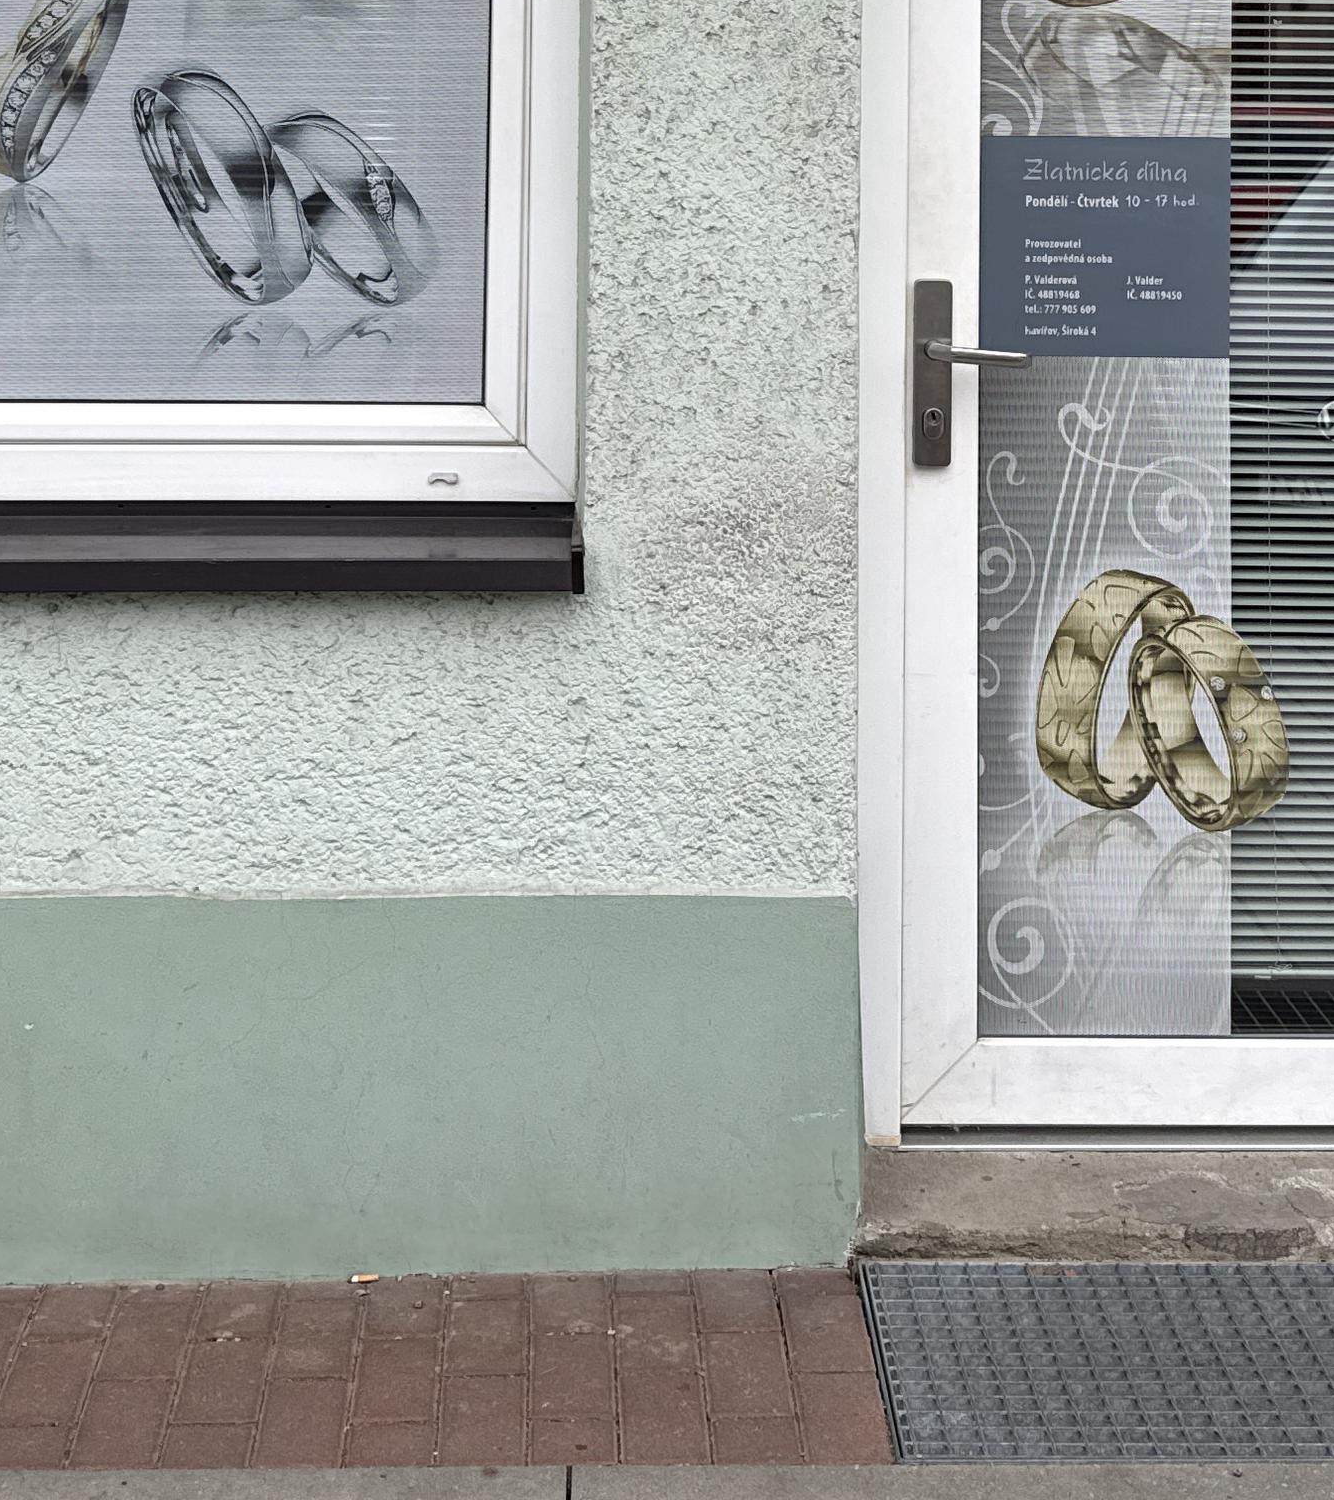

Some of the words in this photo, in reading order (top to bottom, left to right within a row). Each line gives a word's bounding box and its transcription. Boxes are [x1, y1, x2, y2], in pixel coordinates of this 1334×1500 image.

[1023, 158, 1129, 183] Zlatnická
[1136, 160, 1188, 184] dílna
[1025, 194, 1069, 208] Pondělí
[1076, 192, 1120, 208] Čtvrtek
[1125, 194, 1141, 208] 10
[1155, 194, 1168, 208] 17
[1024, 238, 1082, 249] Provozovatel
[1024, 255, 1031, 263] a
[1086, 253, 1113, 264] osoba
[1024, 274, 1033, 285] P.
[1033, 274, 1078, 285] Valderová
[1126, 275, 1134, 286] J.
[1135, 275, 1164, 286] Valder
[1024, 303, 1043, 314] tel.:
[1043, 304, 1060, 314] 777
[1061, 304, 1078, 314] 905
[1079, 304, 1097, 315] 609
[1061, 323, 1089, 336] Široká
[1090, 325, 1097, 336] 4
